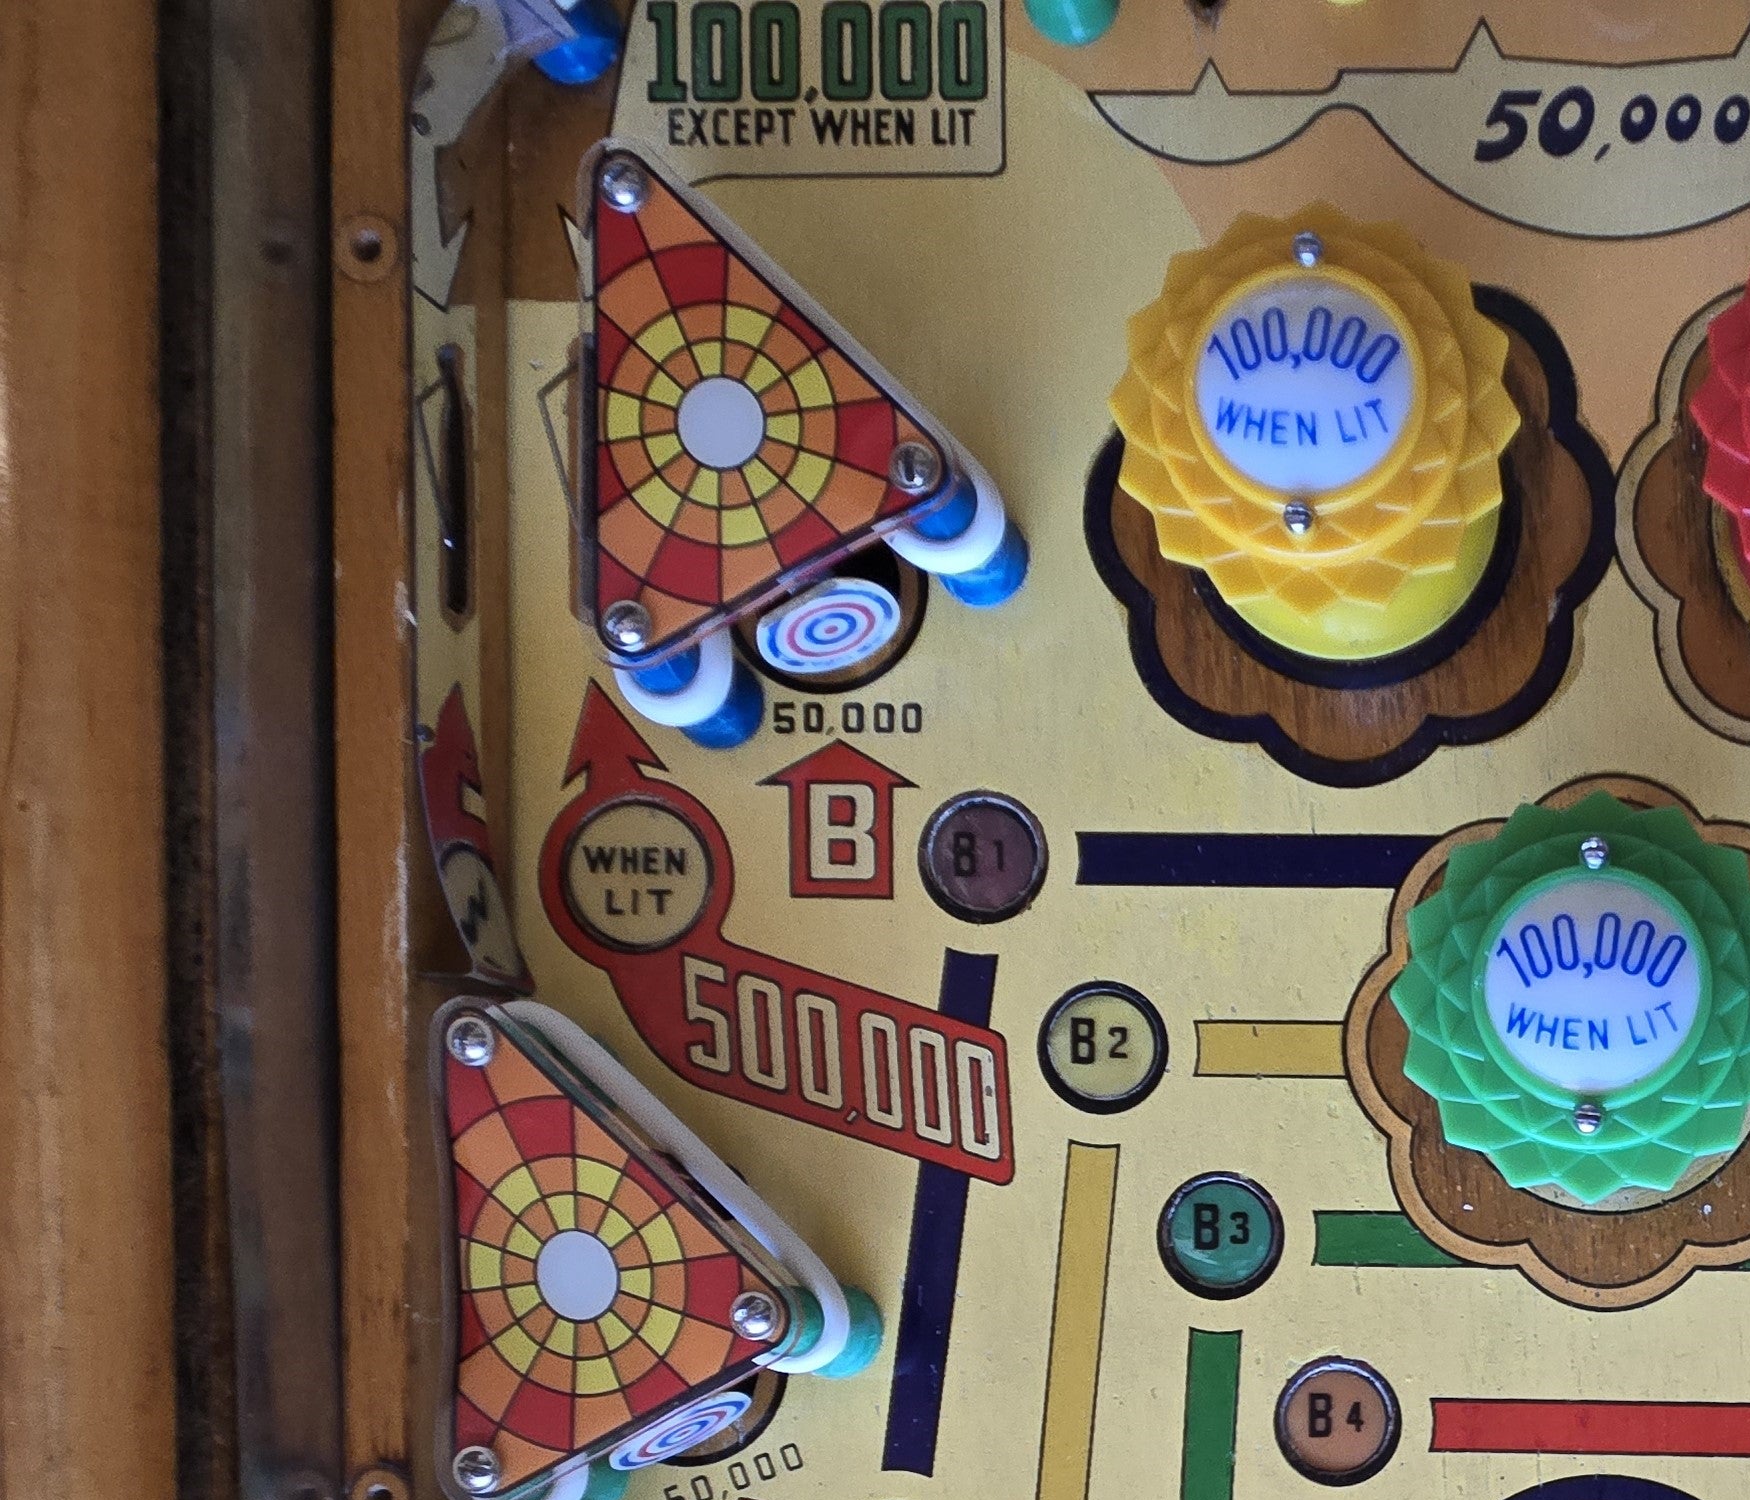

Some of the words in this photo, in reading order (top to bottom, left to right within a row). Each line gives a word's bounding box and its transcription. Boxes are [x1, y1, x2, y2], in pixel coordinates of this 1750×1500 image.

[647, 0, 989, 103] 100,000
[668, 107, 796, 147] EXCEPT
[810, 108, 915, 147] WHEN
[931, 108, 976, 147] LIT
[1207, 306, 1400, 384] 100,000
[1216, 396, 1318, 446] WHEN
[1335, 398, 1388, 443] LIT
[773, 702, 922, 736] 50,000
[808, 783, 876, 880] B
[582, 845, 687, 876] WHEN
[604, 888, 674, 916] LIT
[1496, 912, 1687, 988] 100,000
[1506, 1002, 1609, 1051] WHEN
[1626, 1001, 1678, 1046] LIT
[682, 954, 1002, 1162] 500,000
